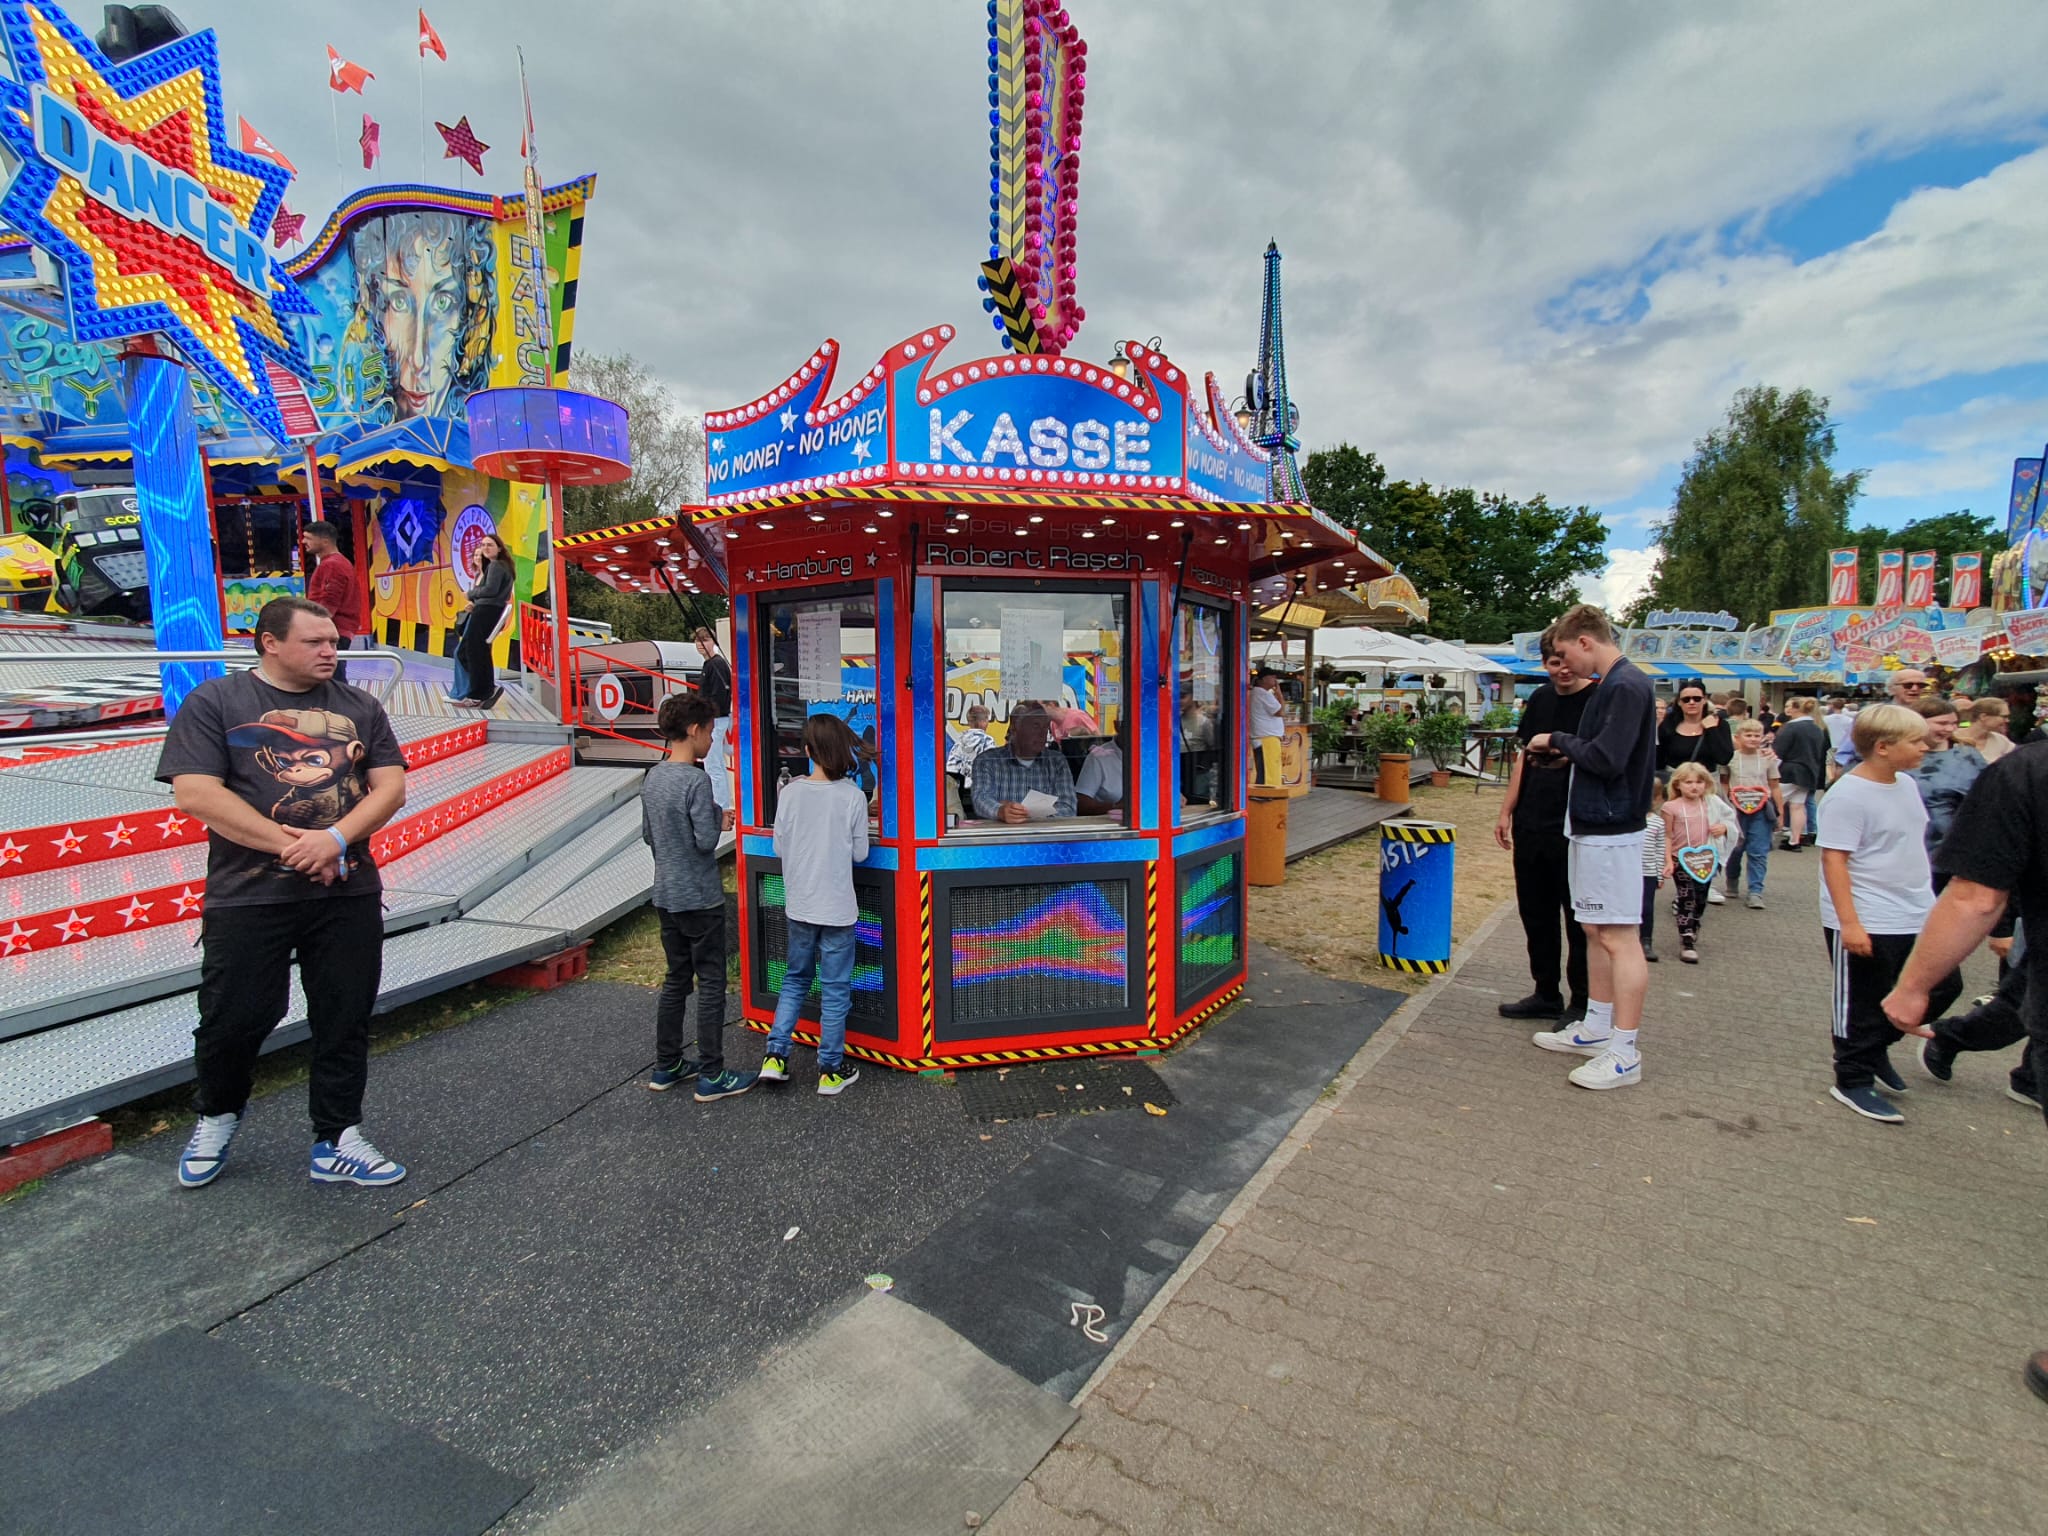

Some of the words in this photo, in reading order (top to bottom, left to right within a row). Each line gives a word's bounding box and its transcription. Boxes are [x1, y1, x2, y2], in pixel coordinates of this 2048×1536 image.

[41, 94, 270, 294] DANCER
[708, 459, 729, 484] NO
[732, 440, 784, 478] MONEY
[799, 428, 824, 456] NO
[829, 405, 887, 446] HONEY
[929, 407, 1151, 472] KASSE
[1187, 448, 1199, 471] NO
[1200, 453, 1228, 484] MONEY
[1234, 469, 1246, 488] NO
[767, 556, 853, 581] Hamburg
[927, 543, 1041, 568] Robert
[1050, 546, 1144, 570] Rasch
[600, 684, 619, 709] D
[1381, 841, 1429, 873] ASTE
